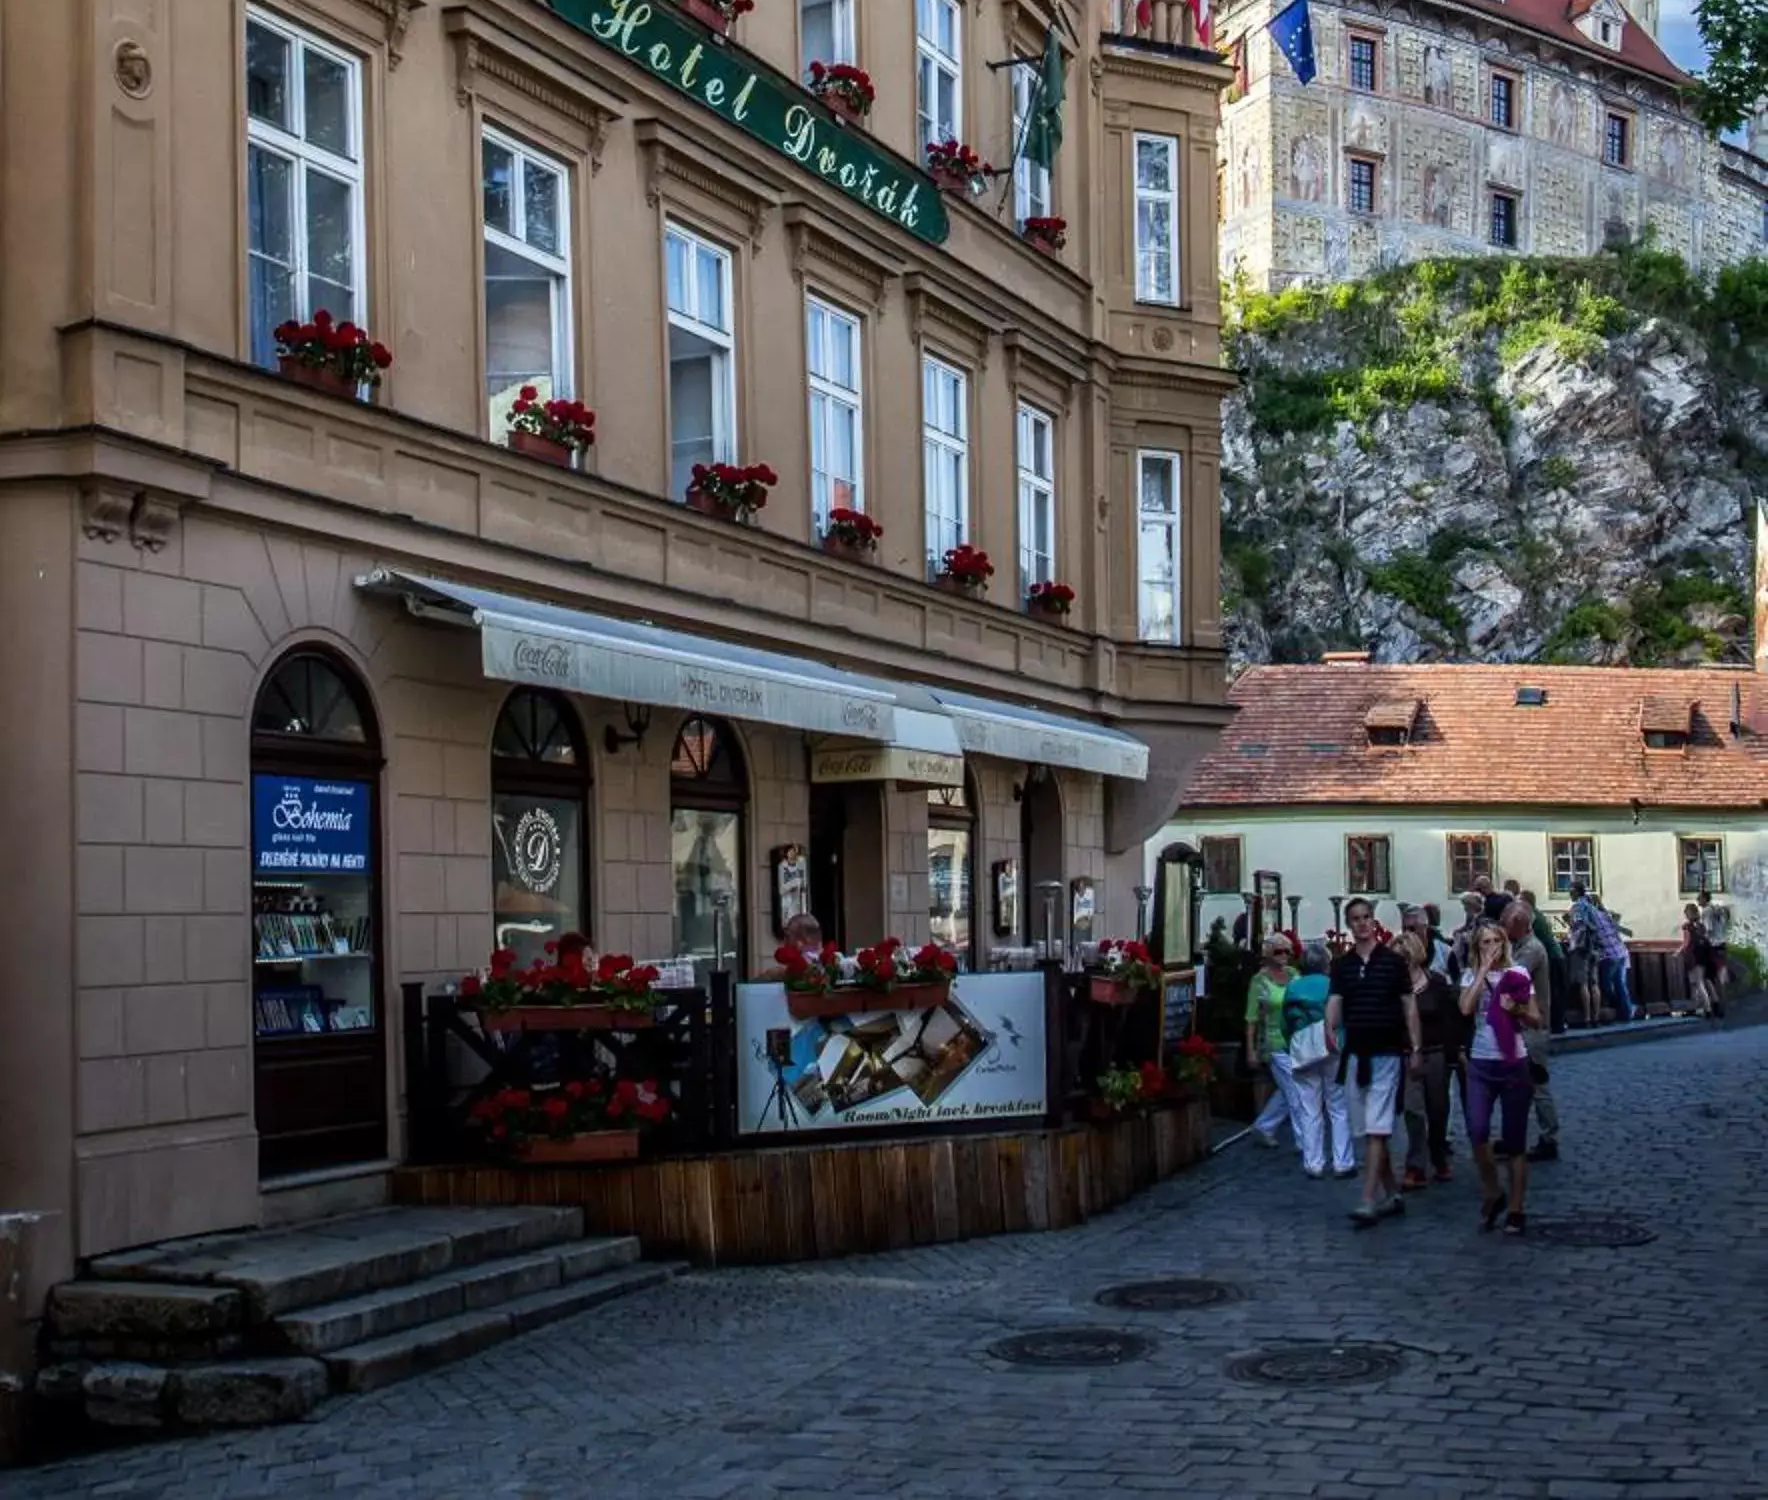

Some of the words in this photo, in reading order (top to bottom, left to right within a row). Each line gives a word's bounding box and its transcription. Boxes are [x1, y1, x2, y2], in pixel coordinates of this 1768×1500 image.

[784, 105, 920, 229] Dvořák
[681, 675, 716, 700] HOTEL
[273, 799, 352, 830] Bohemia
[973, 1100, 1042, 1115] breakfast
